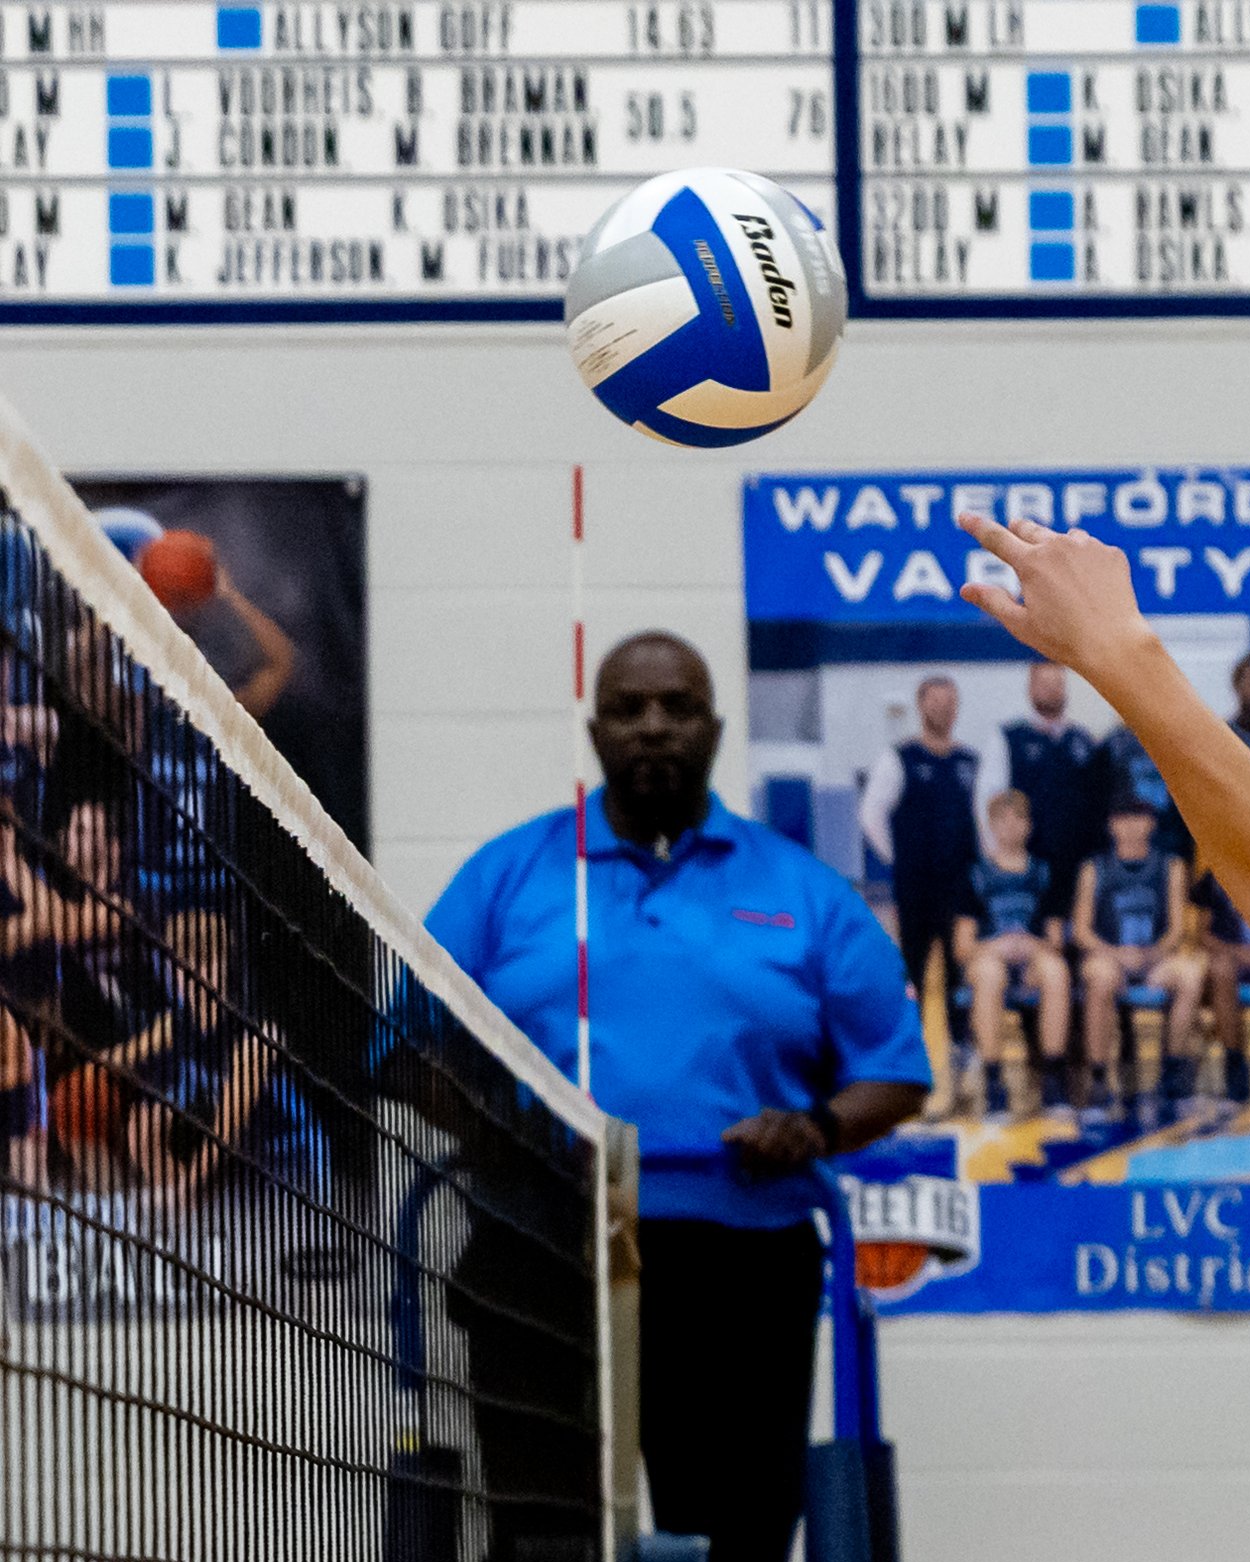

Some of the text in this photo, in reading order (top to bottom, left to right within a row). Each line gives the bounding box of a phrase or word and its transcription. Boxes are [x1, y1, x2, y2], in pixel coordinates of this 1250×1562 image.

[871, 119, 969, 166] RELAY
[731, 212, 798, 331] Baden
[871, 236, 970, 285] RELAY
[1130, 1186, 1243, 1240] LVC
